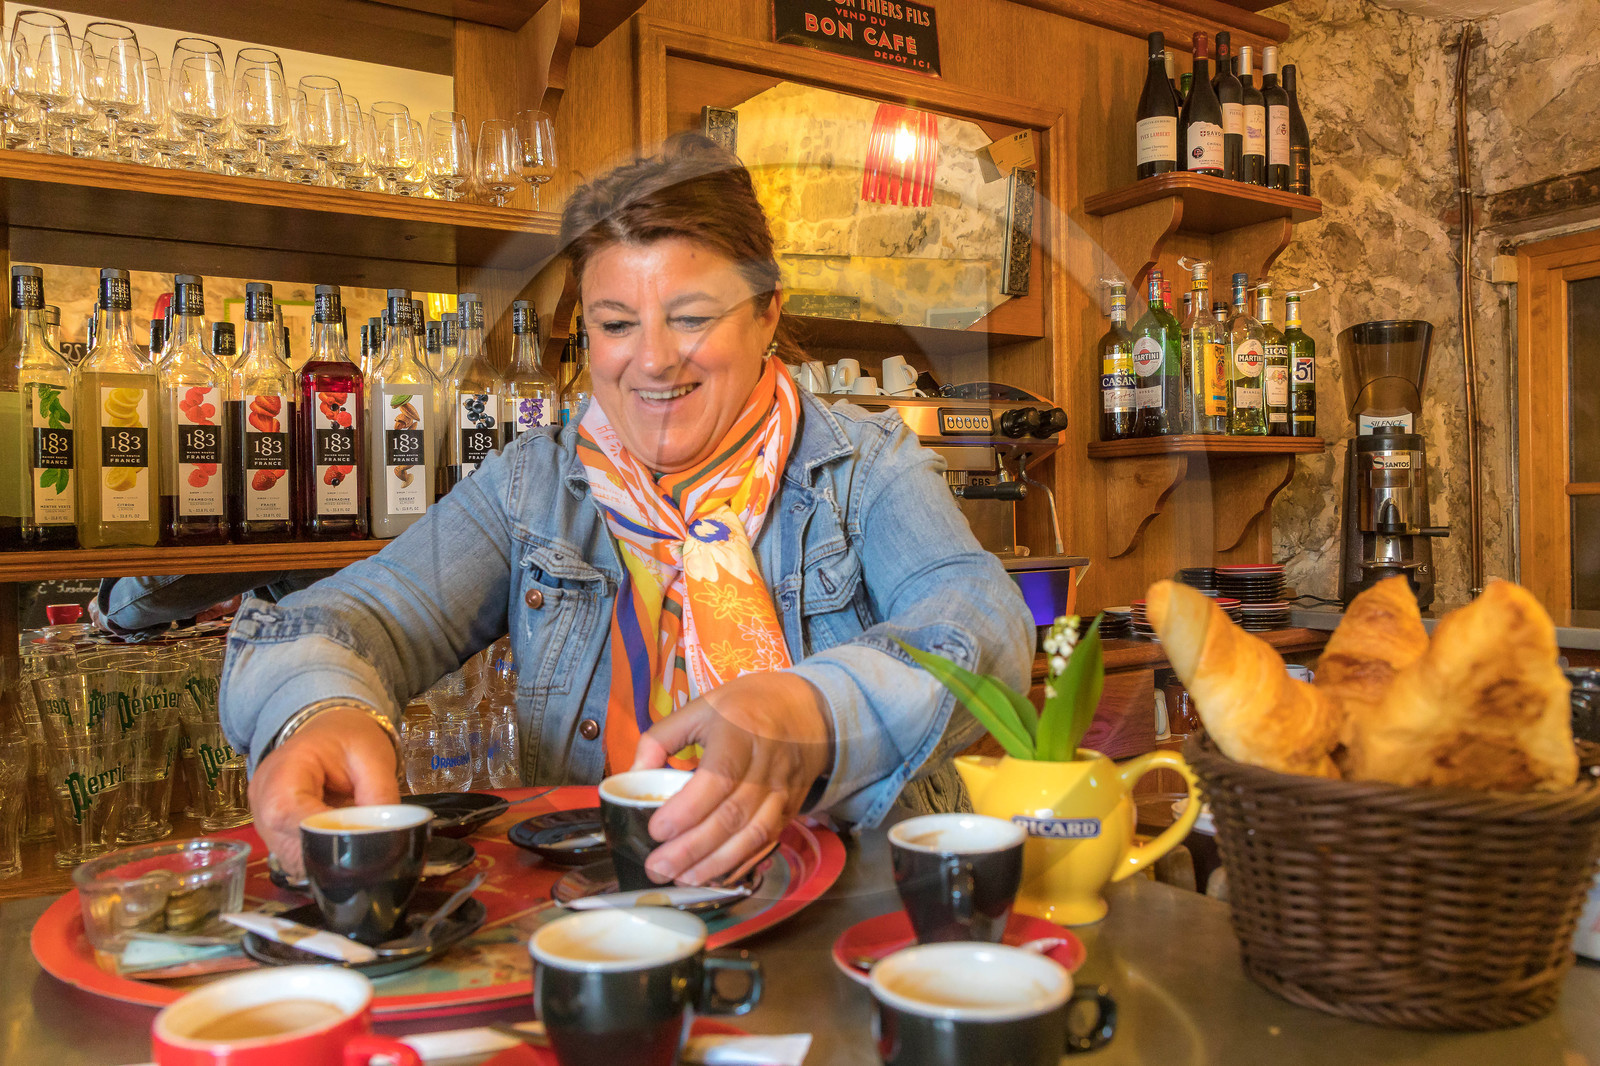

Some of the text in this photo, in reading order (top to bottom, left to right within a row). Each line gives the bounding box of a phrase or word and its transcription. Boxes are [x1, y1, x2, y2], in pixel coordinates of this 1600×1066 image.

[835, 7, 886, 27] VEND DU
[906, 6, 930, 27] FILS
[804, 12, 917, 55] BON CAFÉ
[913, 59, 930, 69] ICI
[1134, 351, 1160, 361] MARTINI
[1295, 361, 1313, 381] 51
[971, 478, 990, 486] CBS
[117, 687, 182, 732] Perrier
[198, 743, 241, 791] Per
